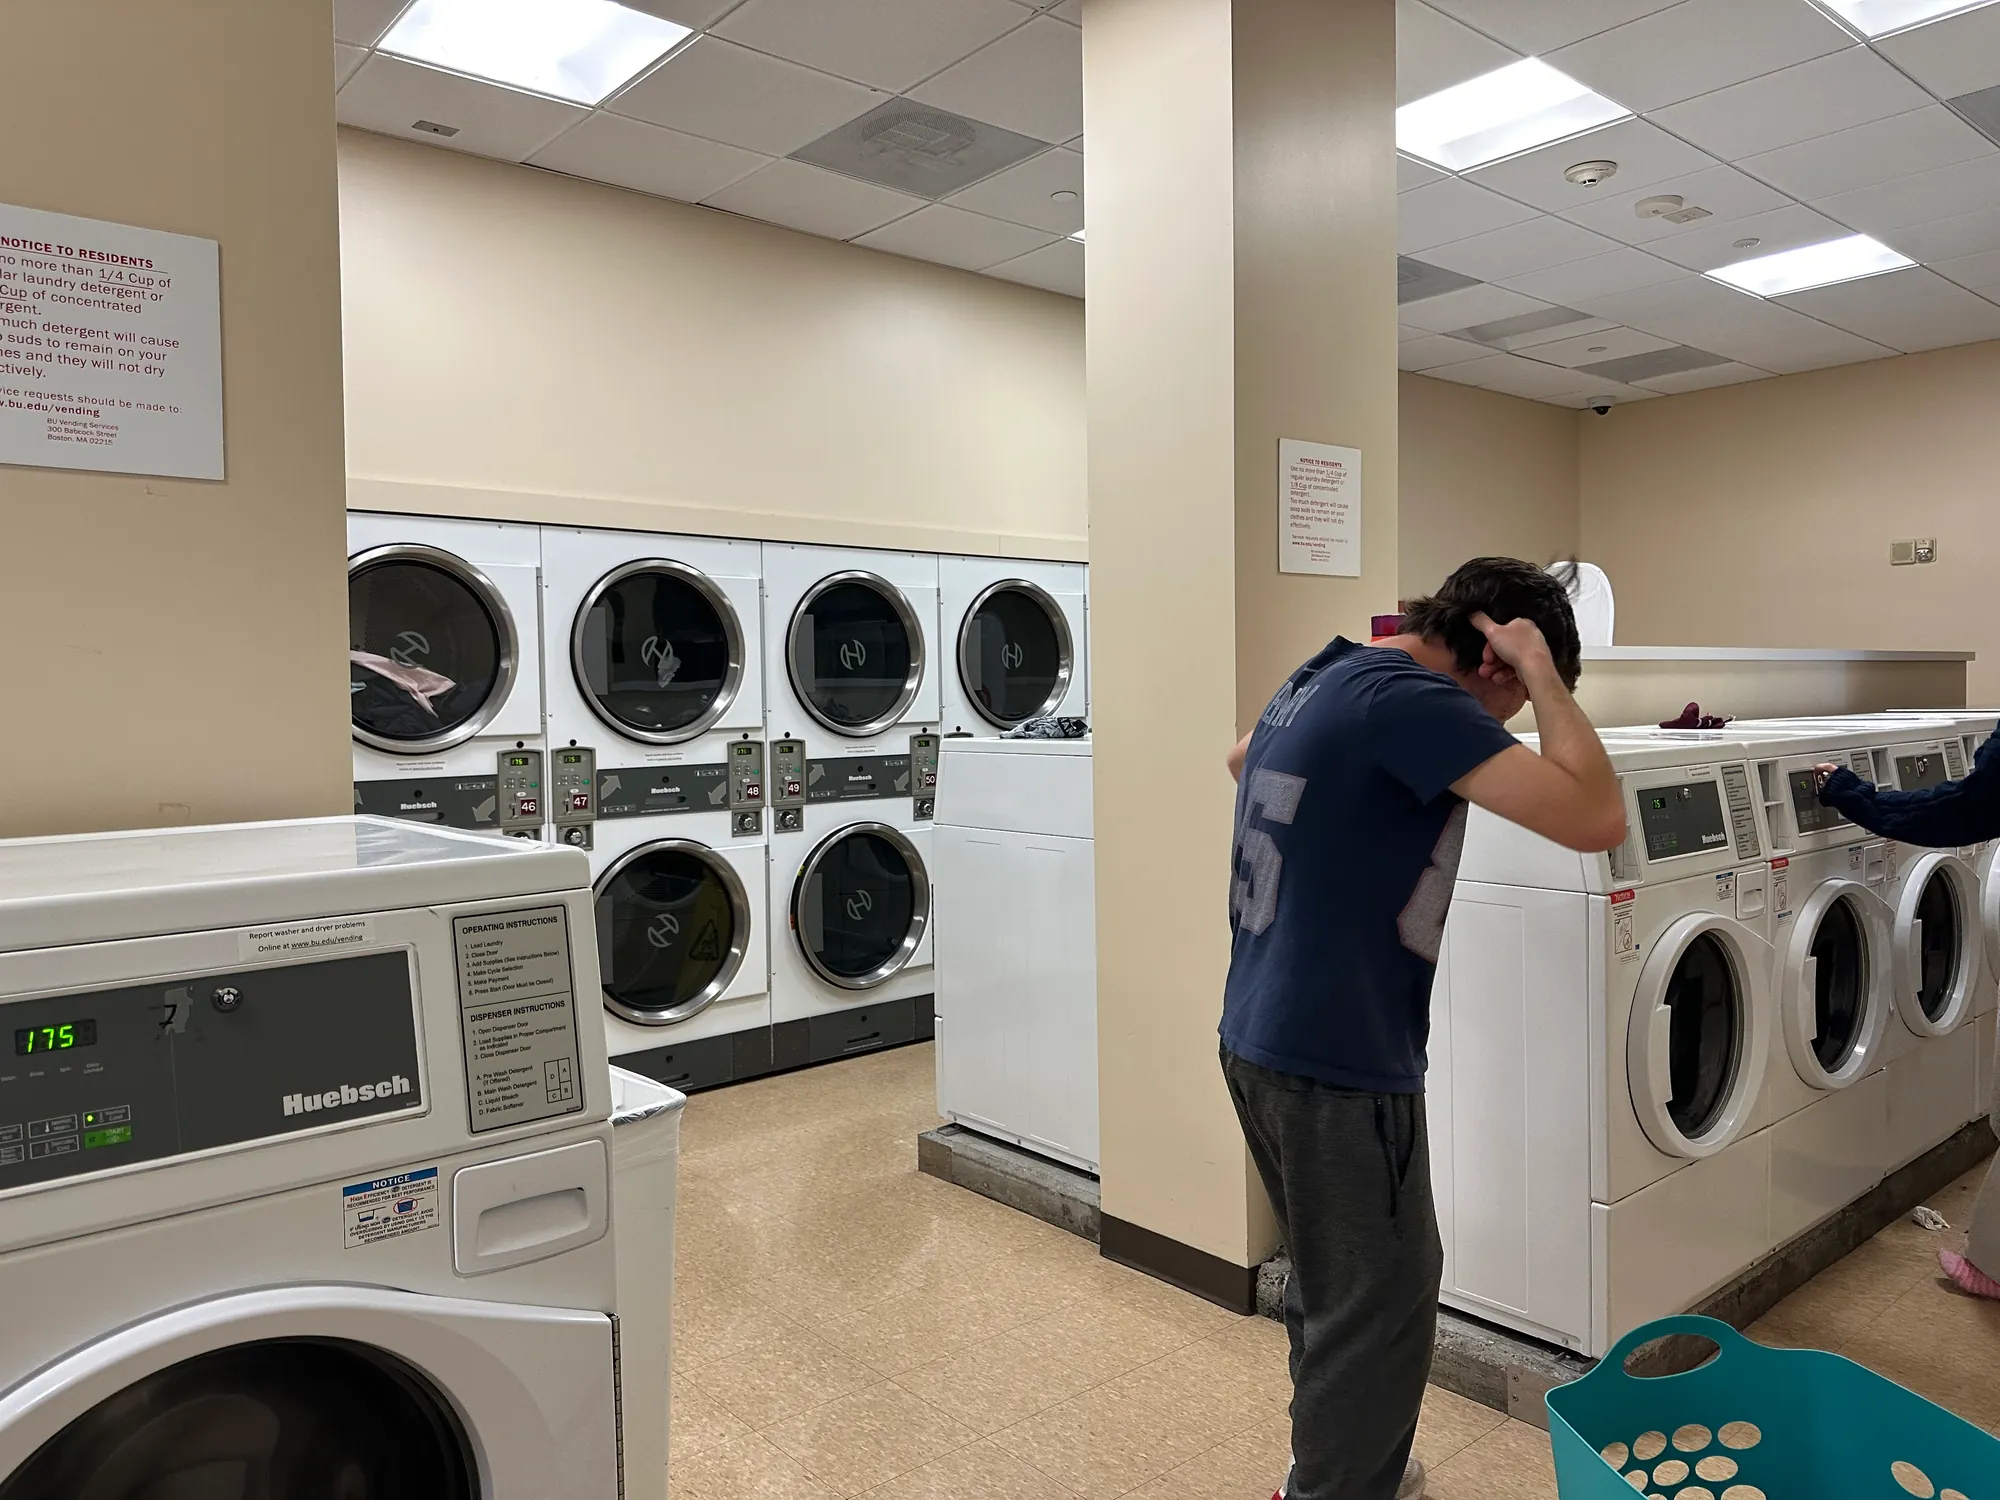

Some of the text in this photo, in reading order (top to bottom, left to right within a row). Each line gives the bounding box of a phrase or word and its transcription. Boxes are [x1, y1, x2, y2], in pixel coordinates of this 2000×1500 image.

[1, 236, 153, 269] NOTICE TO RESIDENTS
[0, 255, 171, 288] no more than 1/4 Cup of
[23, 272, 76, 291] laundry
[81, 282, 146, 299] detergent
[150, 293, 163, 301] or
[0, 284, 142, 313] Cup of concentrated
[0, 317, 179, 348] much detergent will cause
[7, 333, 42, 346] suds
[47, 337, 60, 348] to
[65, 341, 113, 355] remain
[118, 347, 134, 357] on
[139, 350, 167, 361] your
[26, 350, 165, 378] and they will not dry
[24, 389, 182, 414] requests should be made to:
[47, 417, 119, 431] BU Vending Services
[47, 425, 117, 439] 300 Babcock Street
[76, 436, 113, 446] MA 02215
[925, 775, 936, 784] 50
[747, 786, 759, 796] 48
[788, 783, 800, 792] 49
[521, 801, 536, 811] 46
[573, 796, 588, 806] 47
[249, 921, 366, 939] Report washer and dryer problems
[462, 916, 558, 935] OPERATING INSTRUCTIONS
[258, 944, 281, 952] Online
[484, 940, 504, 948] Laundry
[544, 950, 559, 958] Below)
[487, 968, 501, 976] Cycle
[502, 964, 524, 972] Selection
[488, 976, 509, 985] Payment
[502, 984, 515, 992] (Door
[470, 1000, 565, 1022] DISPENSER INSTRUCTIONS
[479, 1025, 566, 1045] Load Supplies Proper Compartment
[492, 1025, 516, 1033] Dispenser
[28, 1025, 74, 1052] 175
[495, 1048, 519, 1057] Dispenser
[509, 1065, 533, 1075] Detergent
[490, 1076, 511, 1085] Offered)
[513, 1080, 537, 1090] Detergent
[283, 1075, 410, 1116] Huebsch
[485, 1093, 519, 1105] Liquid Bleach
[486, 1102, 524, 1114] Fabric Softener
[372, 1174, 411, 1189] NOTICE
[402, 1181, 425, 1190] DETERGENT
[347, 1197, 381, 1208] RECOMMENDED
[403, 1184, 435, 1196] PERFORMANCE
